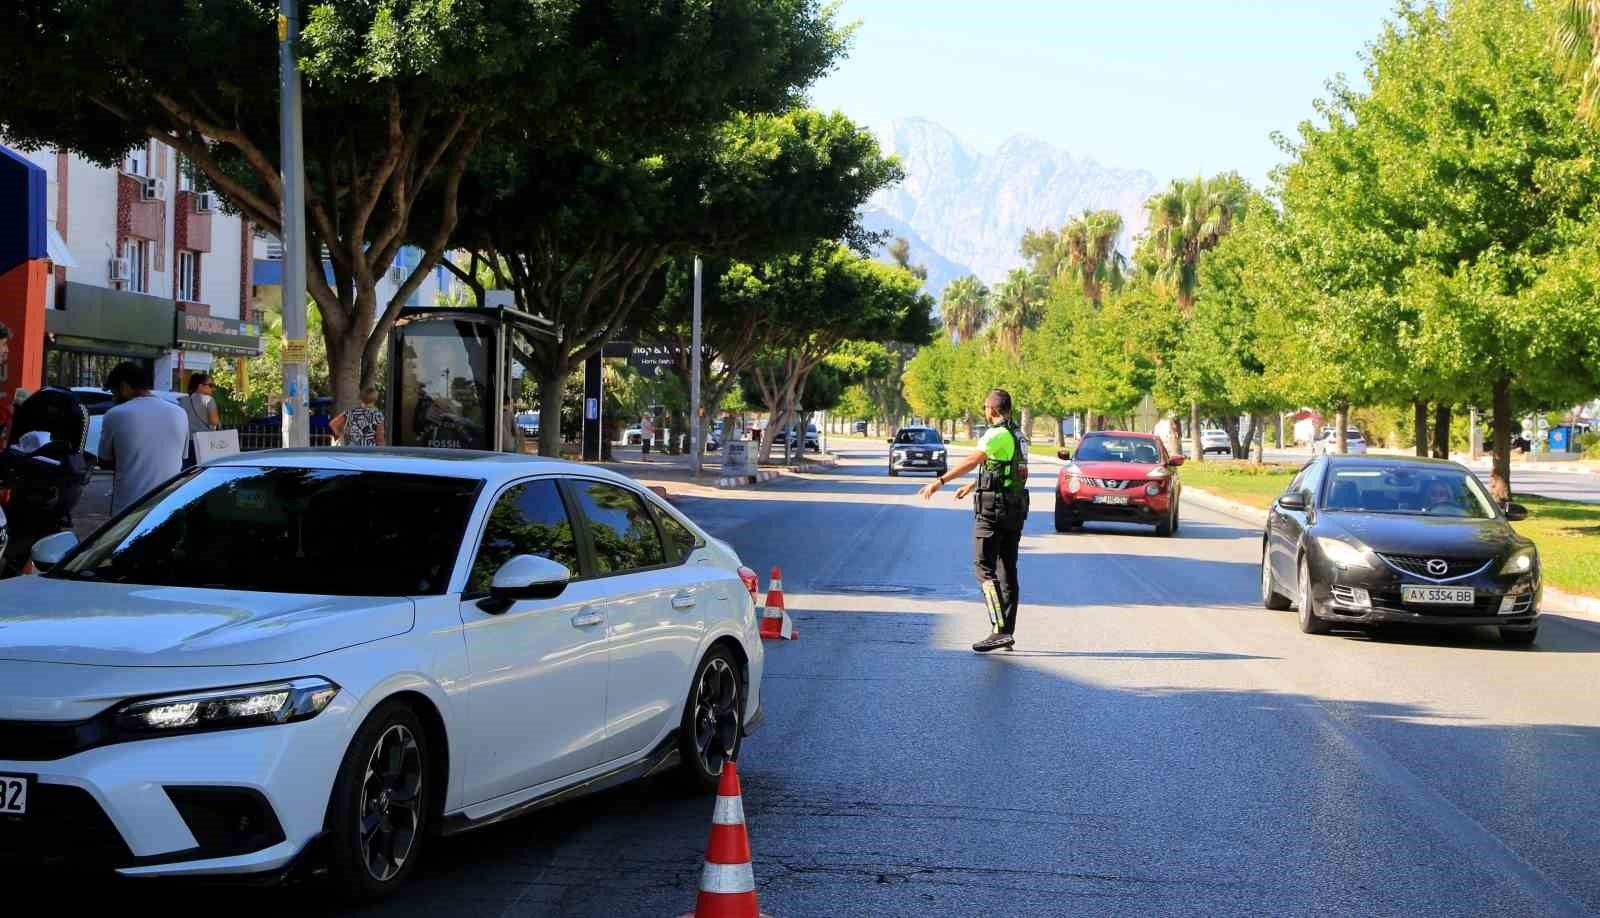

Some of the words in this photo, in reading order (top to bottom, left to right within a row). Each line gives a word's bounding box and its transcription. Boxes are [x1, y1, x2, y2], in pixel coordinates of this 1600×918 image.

[427, 440, 463, 448] FOSSIL
[1410, 590, 1425, 601] AX
[1428, 590, 1453, 601] 5354
[1456, 591, 1472, 602] BB
